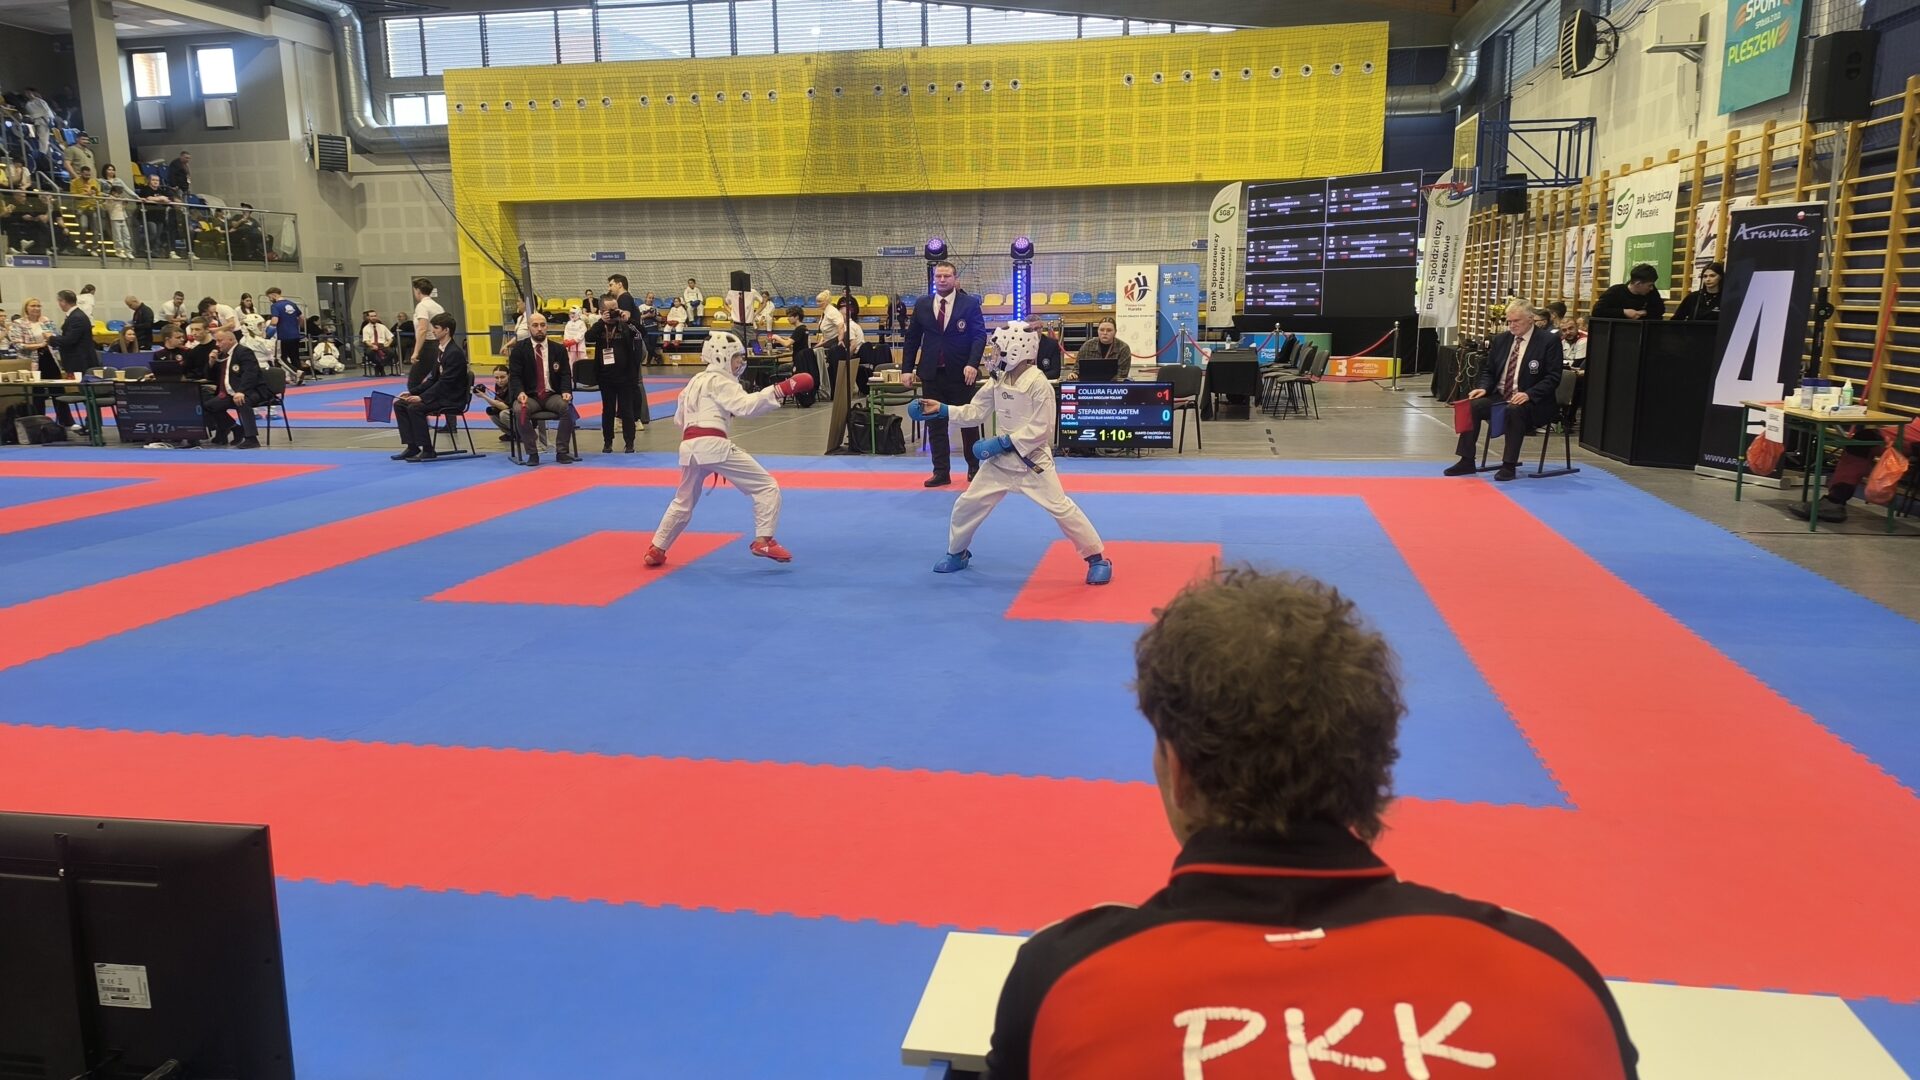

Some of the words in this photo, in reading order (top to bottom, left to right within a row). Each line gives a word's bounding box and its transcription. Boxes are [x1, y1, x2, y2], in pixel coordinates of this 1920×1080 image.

[1727, 25, 1780, 67] PLESZEW
[1429, 219, 1445, 283] Spółdzielczy
[1733, 222, 1811, 242] Arawaza
[1218, 246, 1226, 290] Pleszewie
[1438, 235, 1451, 285] Pleszewie
[1426, 283, 1435, 310] Bank
[1335, 359, 1348, 376] 3
[1712, 270, 1795, 435] 4
[1162, 409, 1171, 421] 0
[1174, 1000, 1497, 1080] PKK
